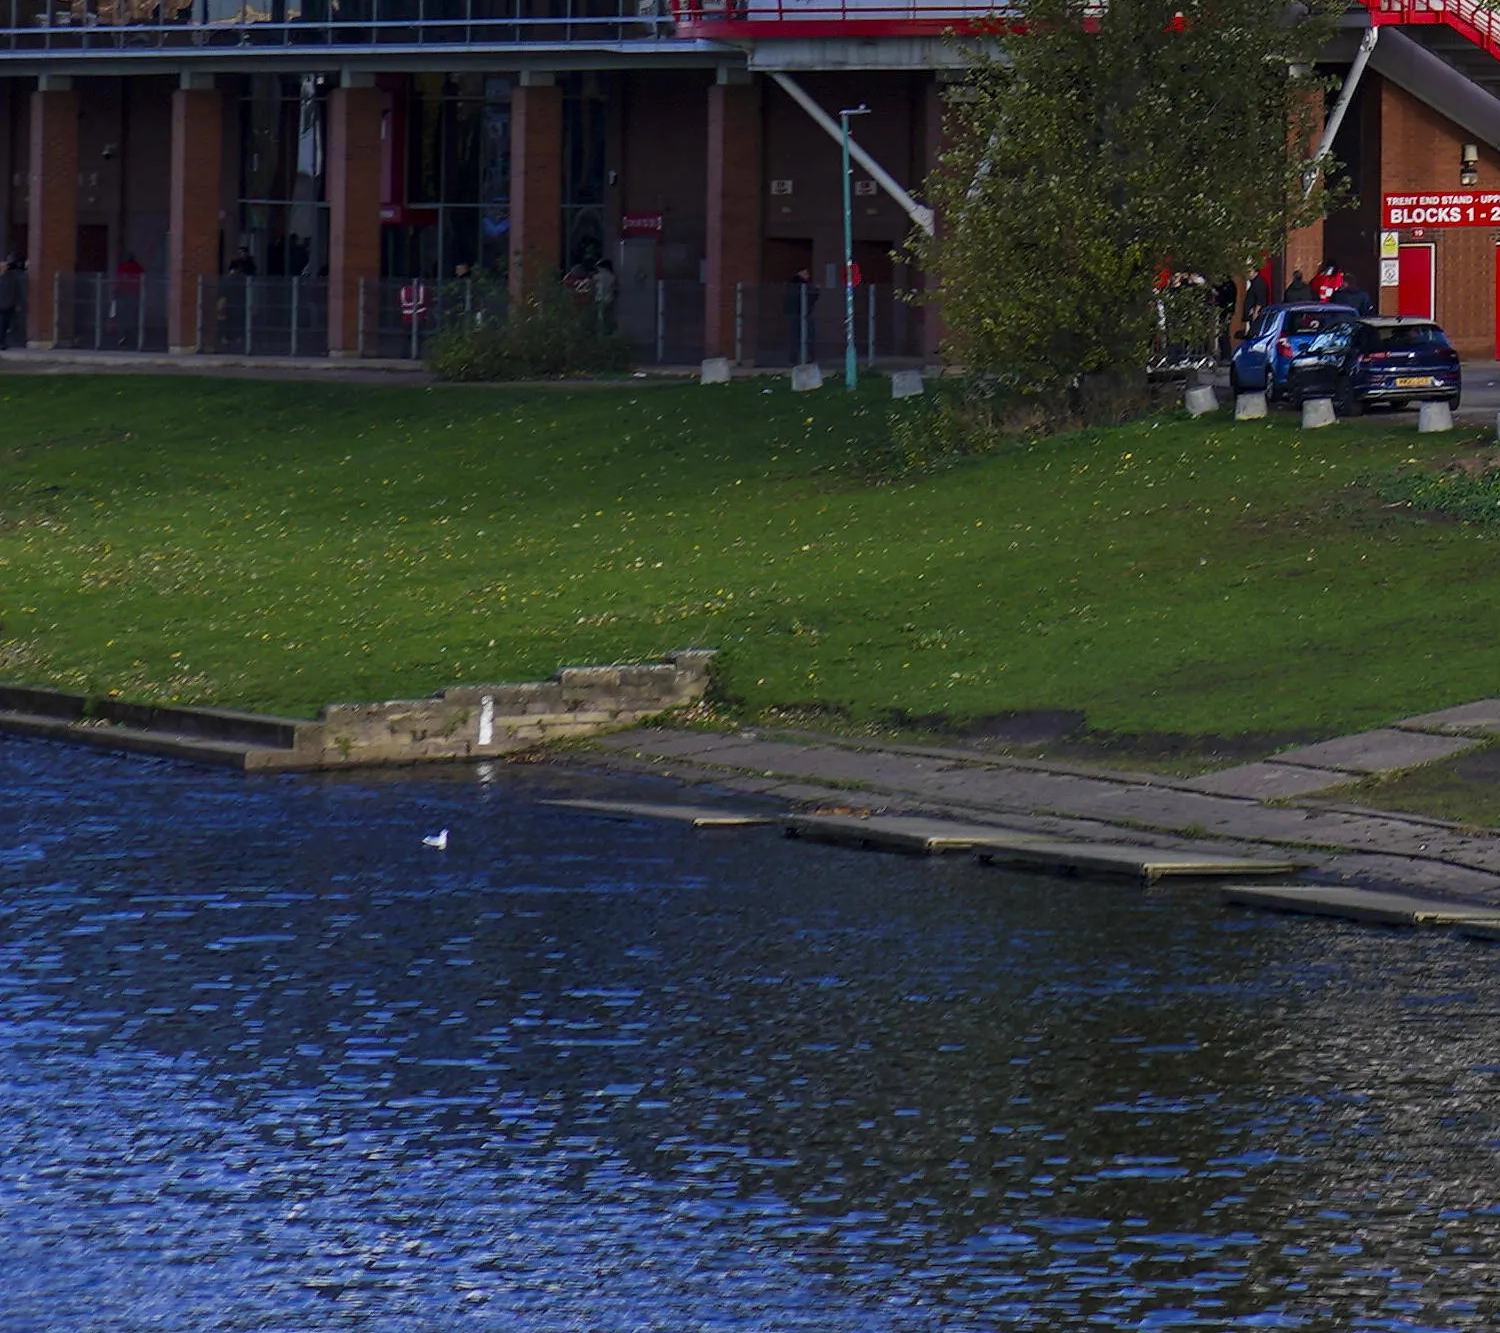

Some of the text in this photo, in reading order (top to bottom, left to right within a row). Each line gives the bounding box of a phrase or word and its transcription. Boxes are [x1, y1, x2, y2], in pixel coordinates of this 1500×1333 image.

[1386, 196, 1417, 206] TRENT
[1419, 195, 1439, 206] END
[1440, 194, 1473, 205] STAND
[1390, 207, 1462, 224] BLOCKS
[1465, 207, 1475, 222] 1
[1490, 206, 1500, 221] 2
